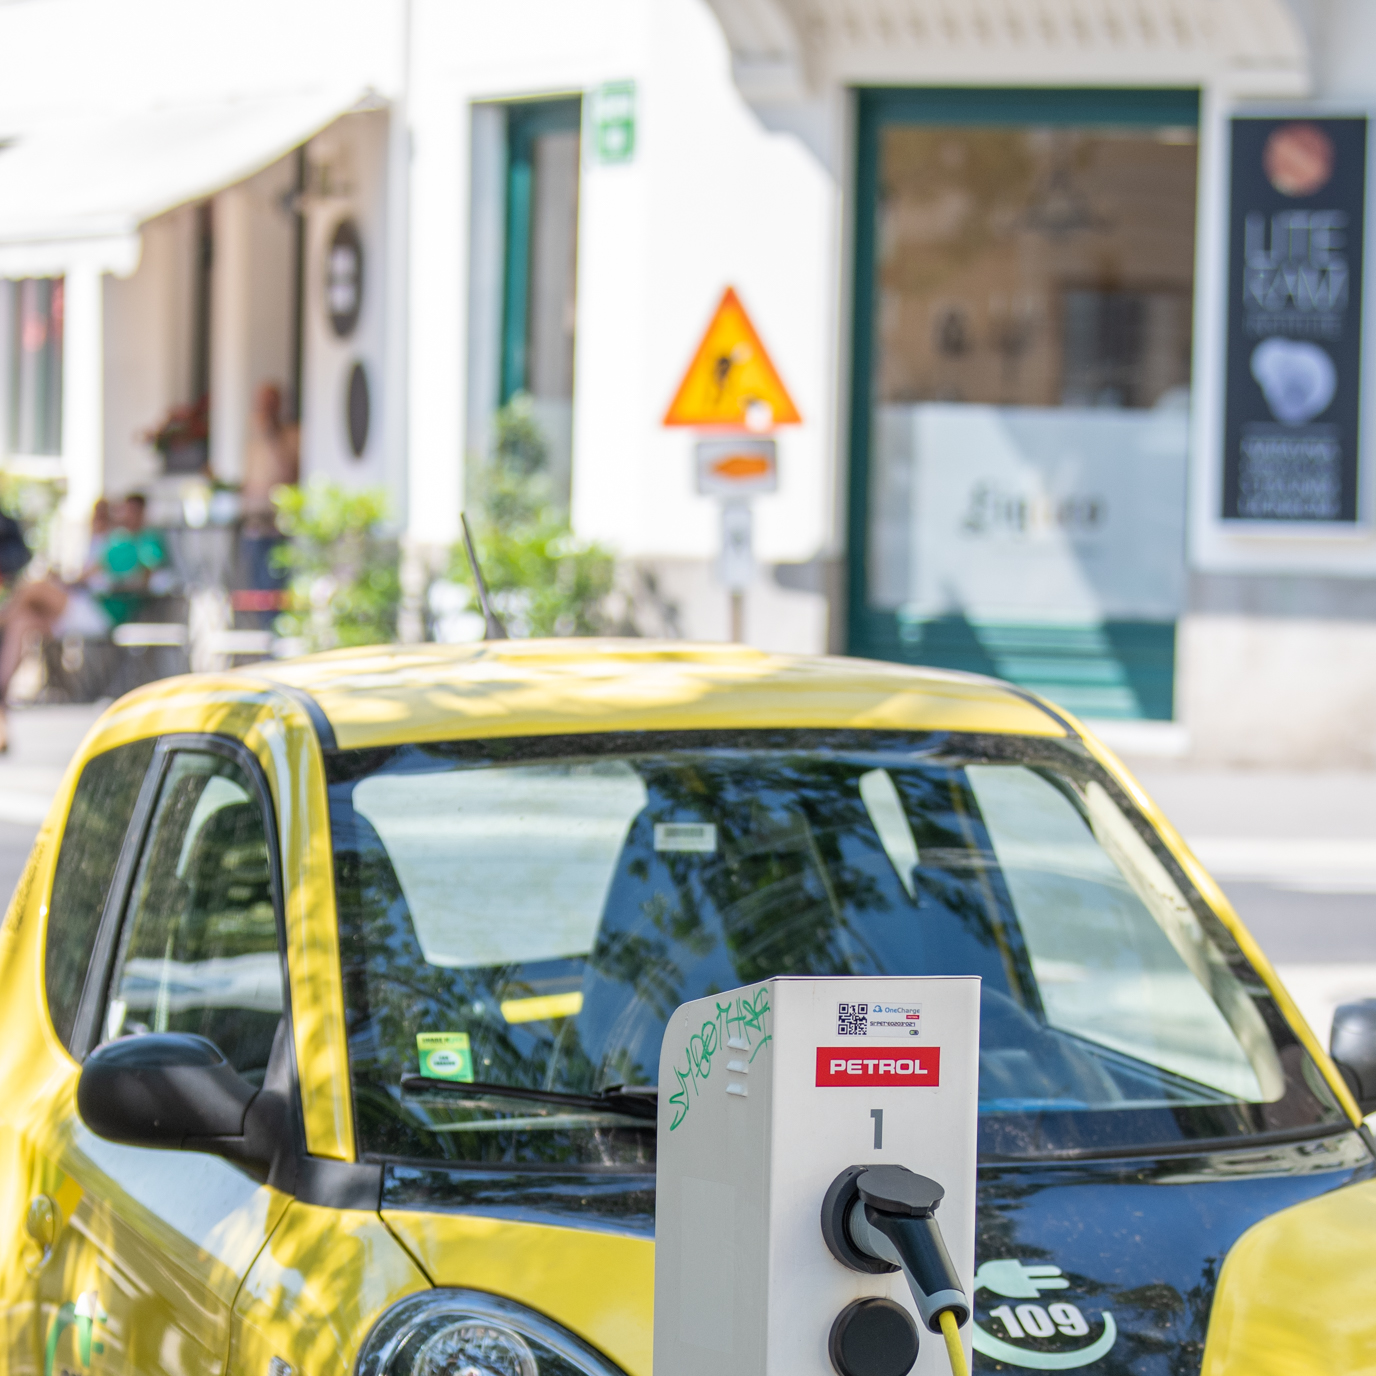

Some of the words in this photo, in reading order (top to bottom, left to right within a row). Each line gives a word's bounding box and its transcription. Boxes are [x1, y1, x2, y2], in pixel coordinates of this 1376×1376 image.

[884, 1006, 920, 1015] OneCharge
[829, 1058, 928, 1075] PETROL
[870, 1108, 884, 1150] 1
[989, 1302, 1090, 1338] 109
